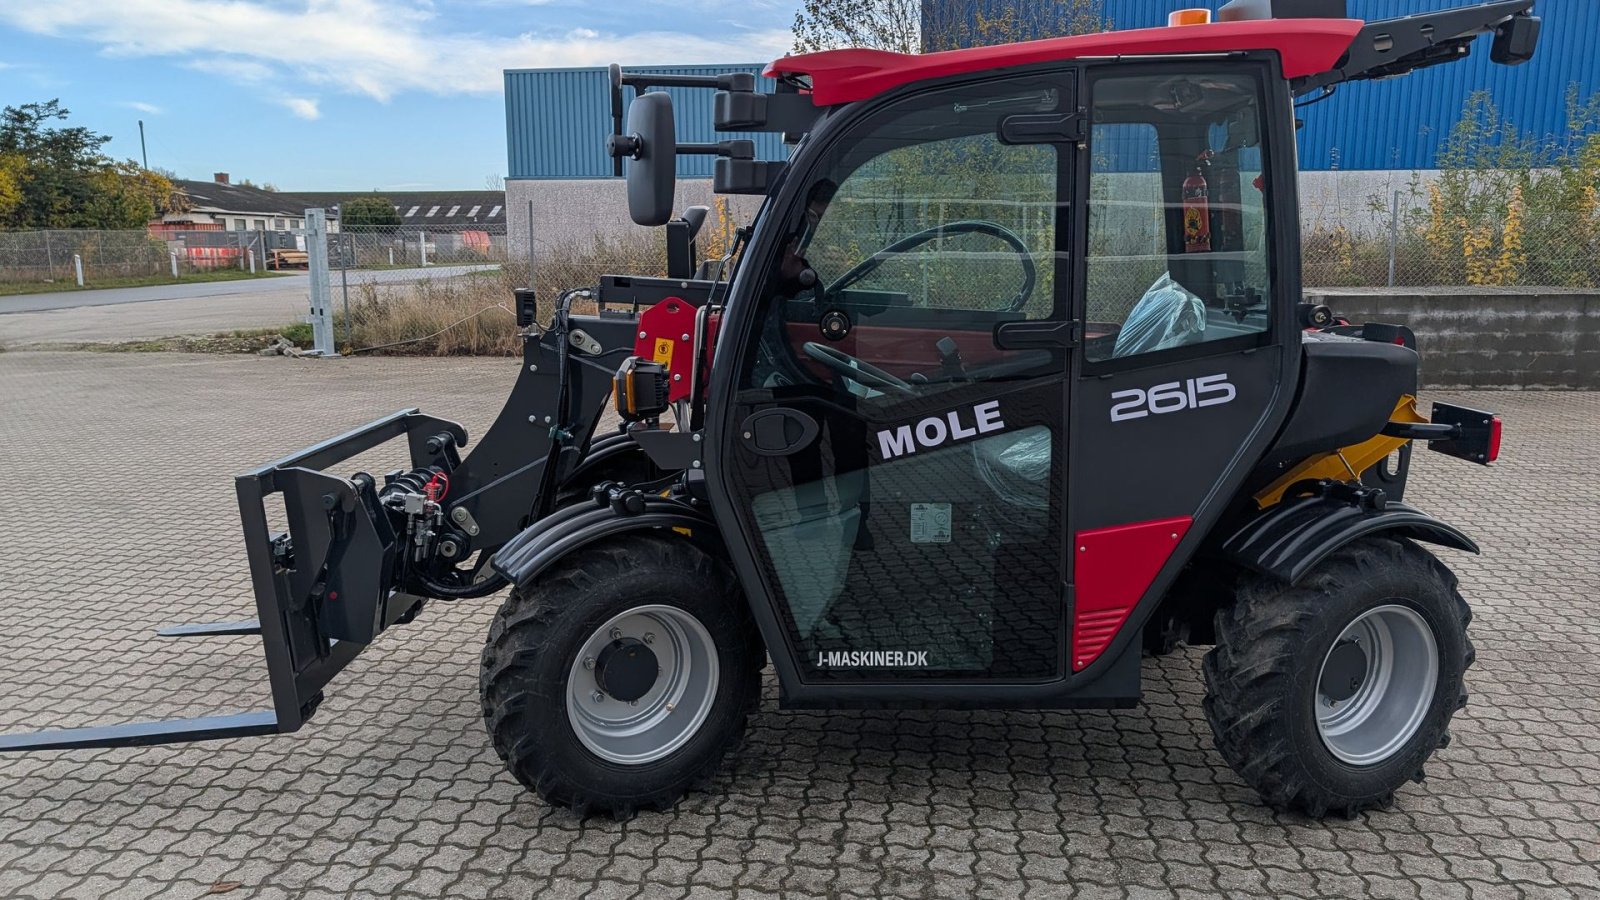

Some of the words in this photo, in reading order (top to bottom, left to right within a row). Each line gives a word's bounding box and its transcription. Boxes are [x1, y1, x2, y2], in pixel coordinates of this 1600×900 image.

[1110, 373, 1236, 422] 2615
[877, 400, 1005, 459] MOLE
[816, 651, 928, 667] J-MASKINER.DK
